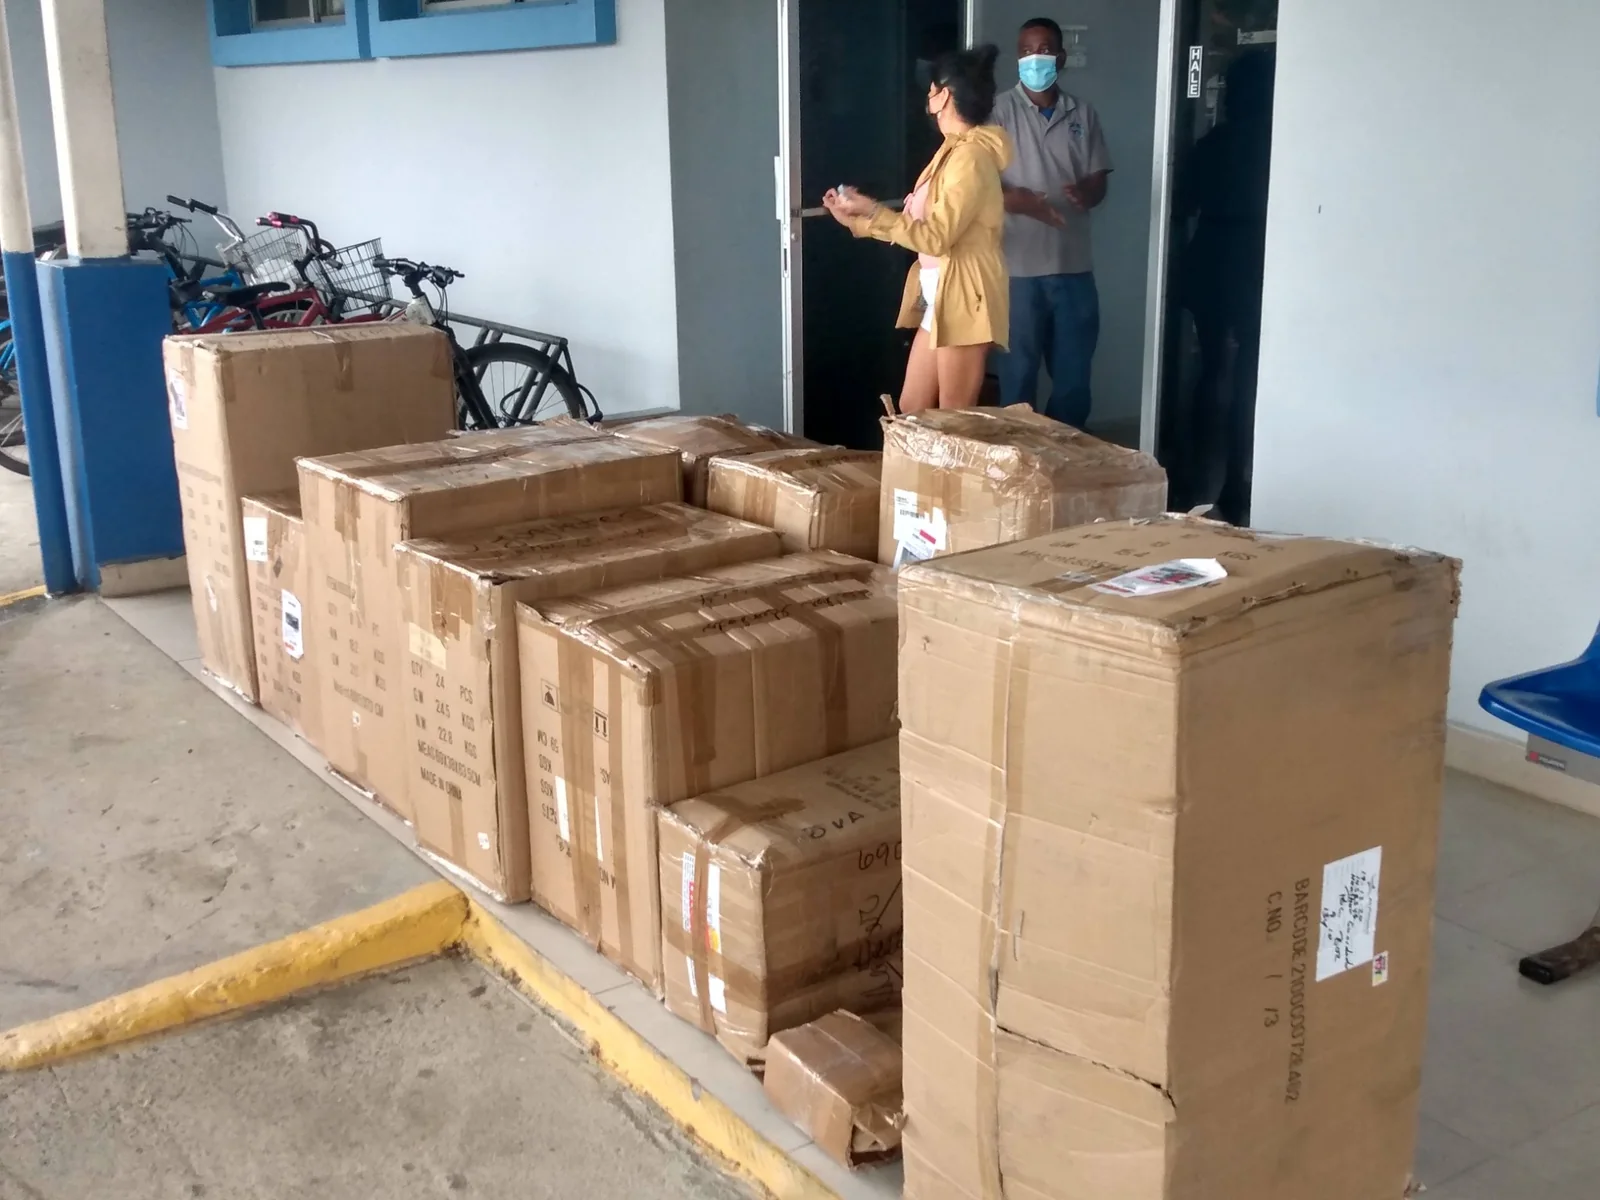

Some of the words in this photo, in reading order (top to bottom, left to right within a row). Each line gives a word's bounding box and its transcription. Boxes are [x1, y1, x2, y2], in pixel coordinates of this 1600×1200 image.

[1190, 48, 1200, 95] HALE
[435, 672, 445, 689] 24
[459, 684, 473, 705] PCS
[420, 765, 437, 788] MADE
